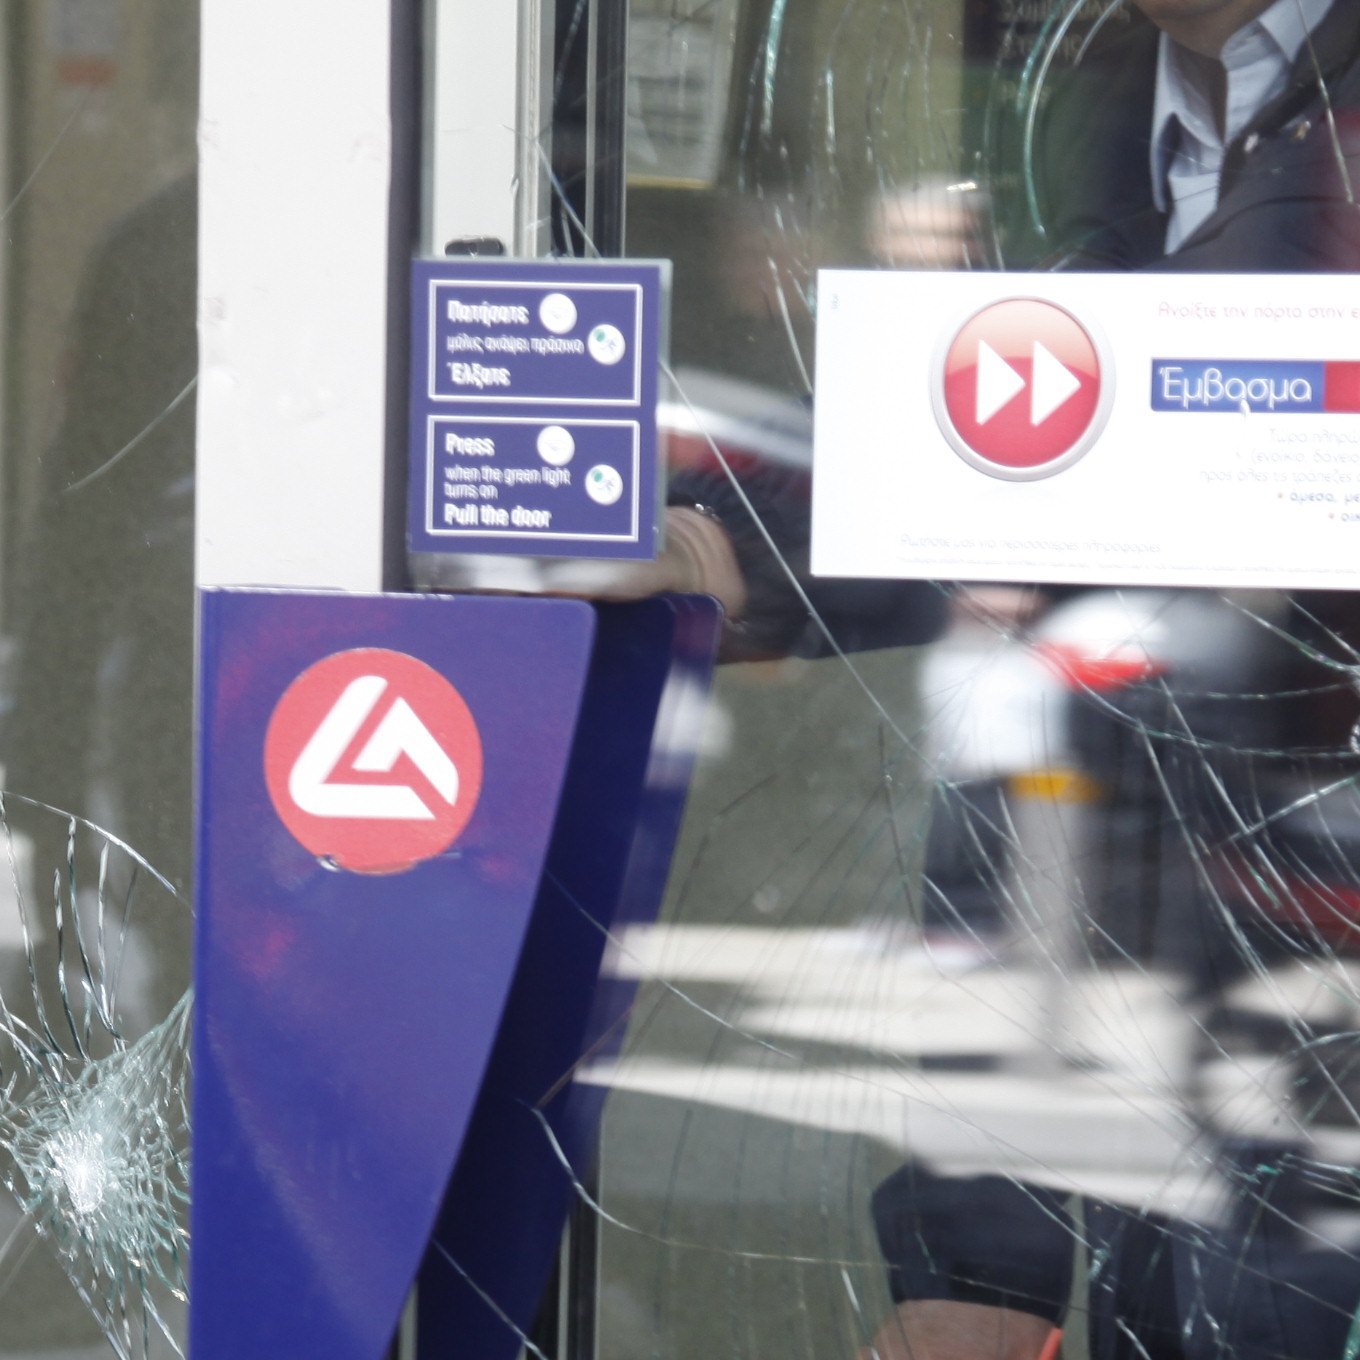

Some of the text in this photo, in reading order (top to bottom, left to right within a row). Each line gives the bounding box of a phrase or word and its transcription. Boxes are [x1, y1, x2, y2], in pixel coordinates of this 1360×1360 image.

[1223, 305, 1248, 318] την
[1308, 305, 1345, 318] στην
[1159, 366, 1312, 410] Έμβασμα
[445, 433, 495, 456] Press
[444, 464, 571, 488] when the green light
[1344, 493, 1360, 507] με
[444, 503, 552, 528] Pull the door
